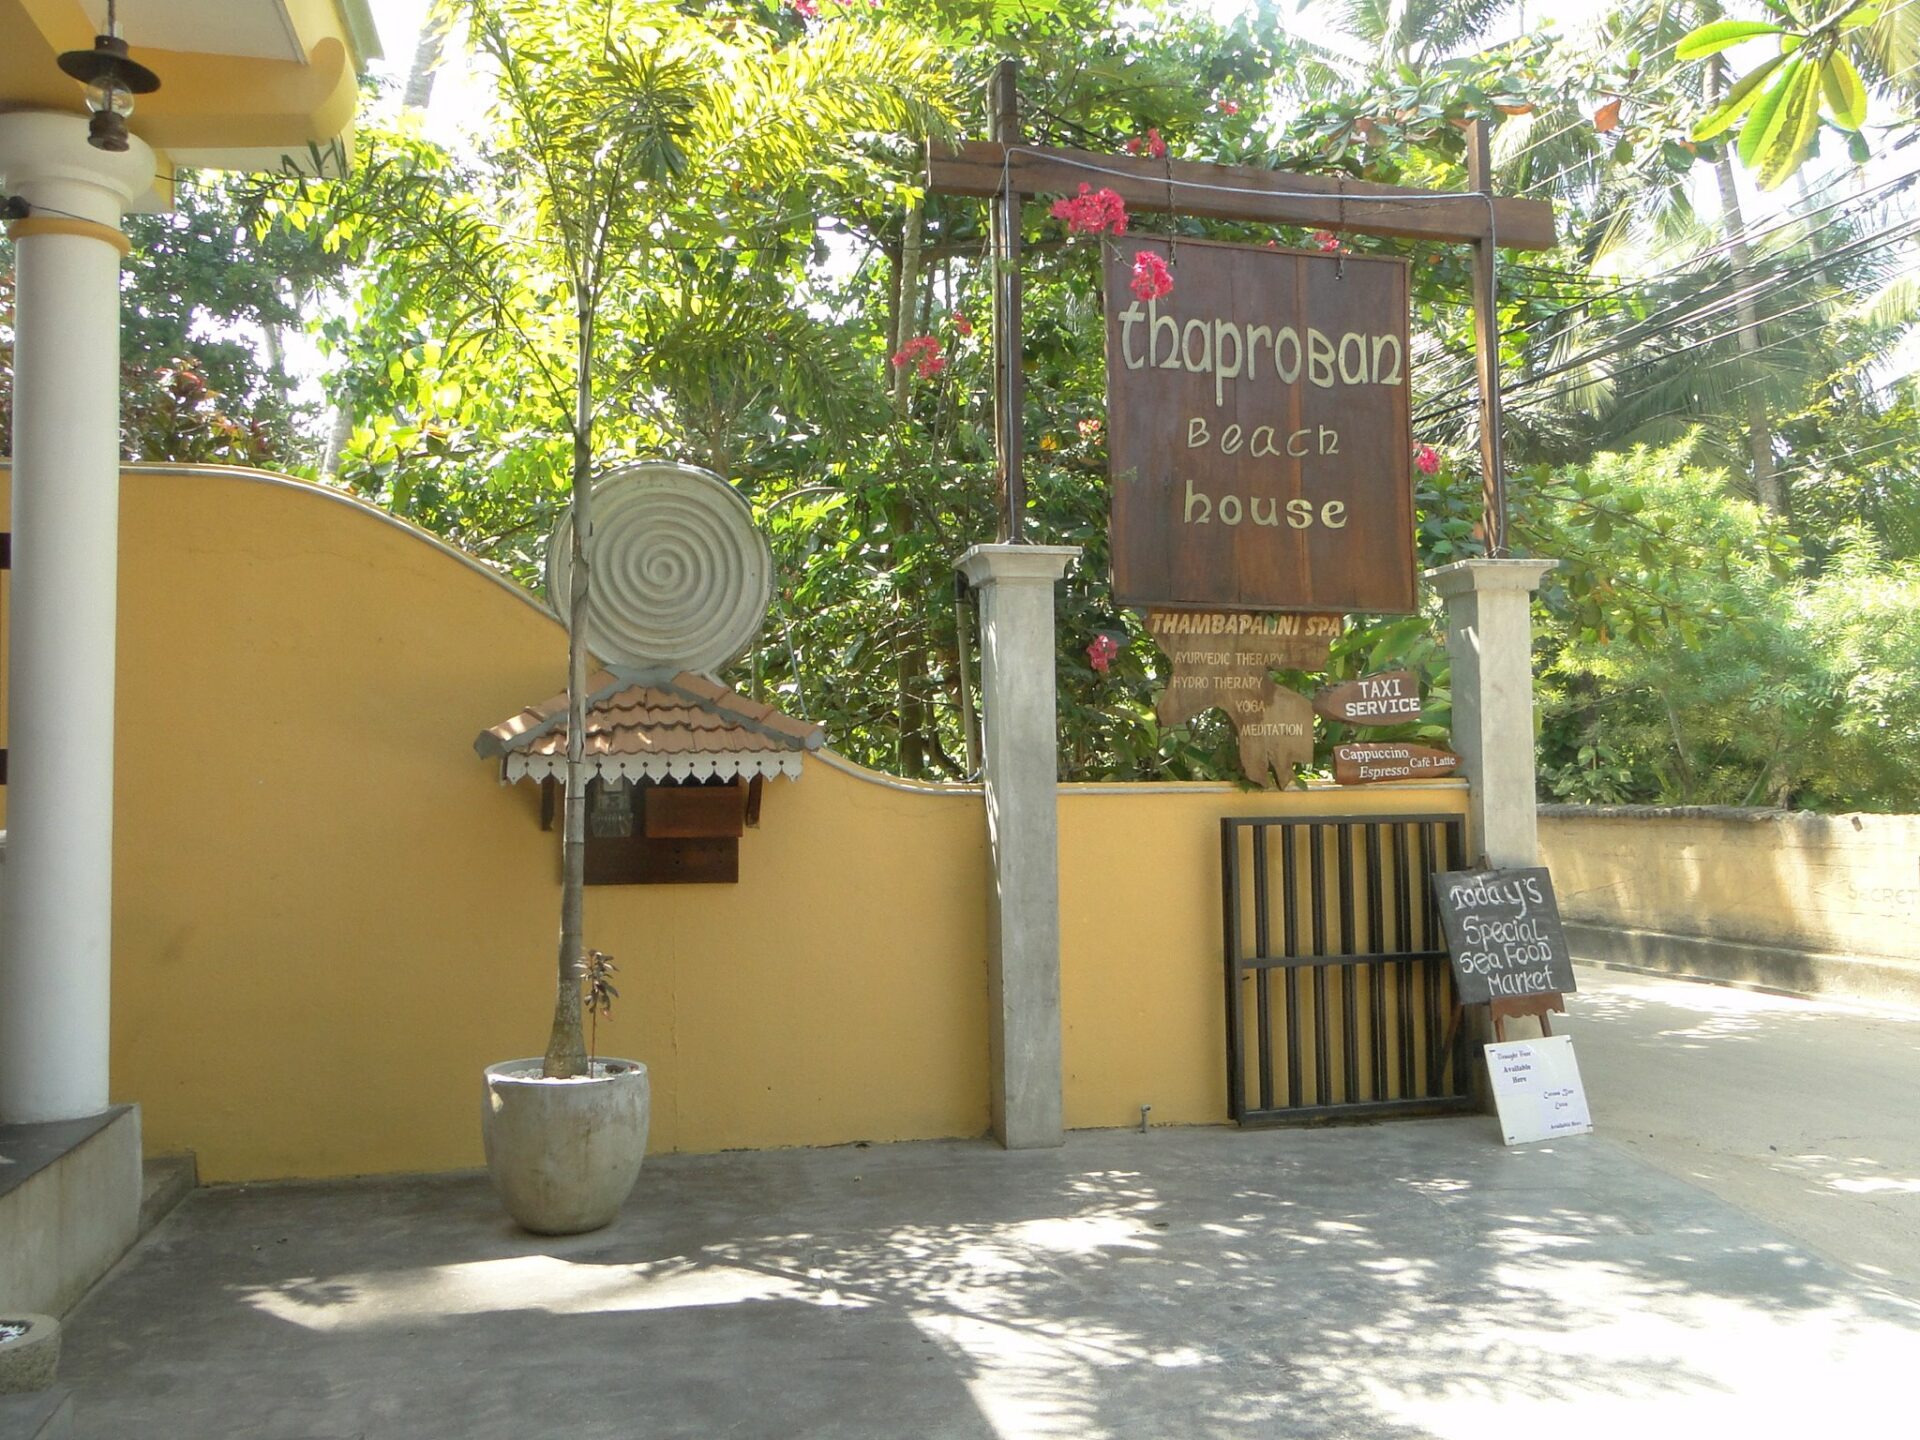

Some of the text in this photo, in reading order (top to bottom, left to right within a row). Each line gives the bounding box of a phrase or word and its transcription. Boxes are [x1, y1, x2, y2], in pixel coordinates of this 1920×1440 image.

[1184, 479, 1348, 529] house
[1305, 617, 1342, 636] SPA
[1174, 652, 1284, 666] AYURVEDIC THERAPY
[1173, 676, 1263, 689] HYDRO THERAPY
[1358, 679, 1401, 698] TAXI
[1235, 700, 1265, 713] YOGA
[1345, 697, 1420, 717] SERVICE
[1241, 723, 1303, 736] MEDITATION
[1340, 747, 1409, 763] Cappuccino
[1433, 756, 1456, 767] Latte
[1359, 766, 1410, 780] Espresso
